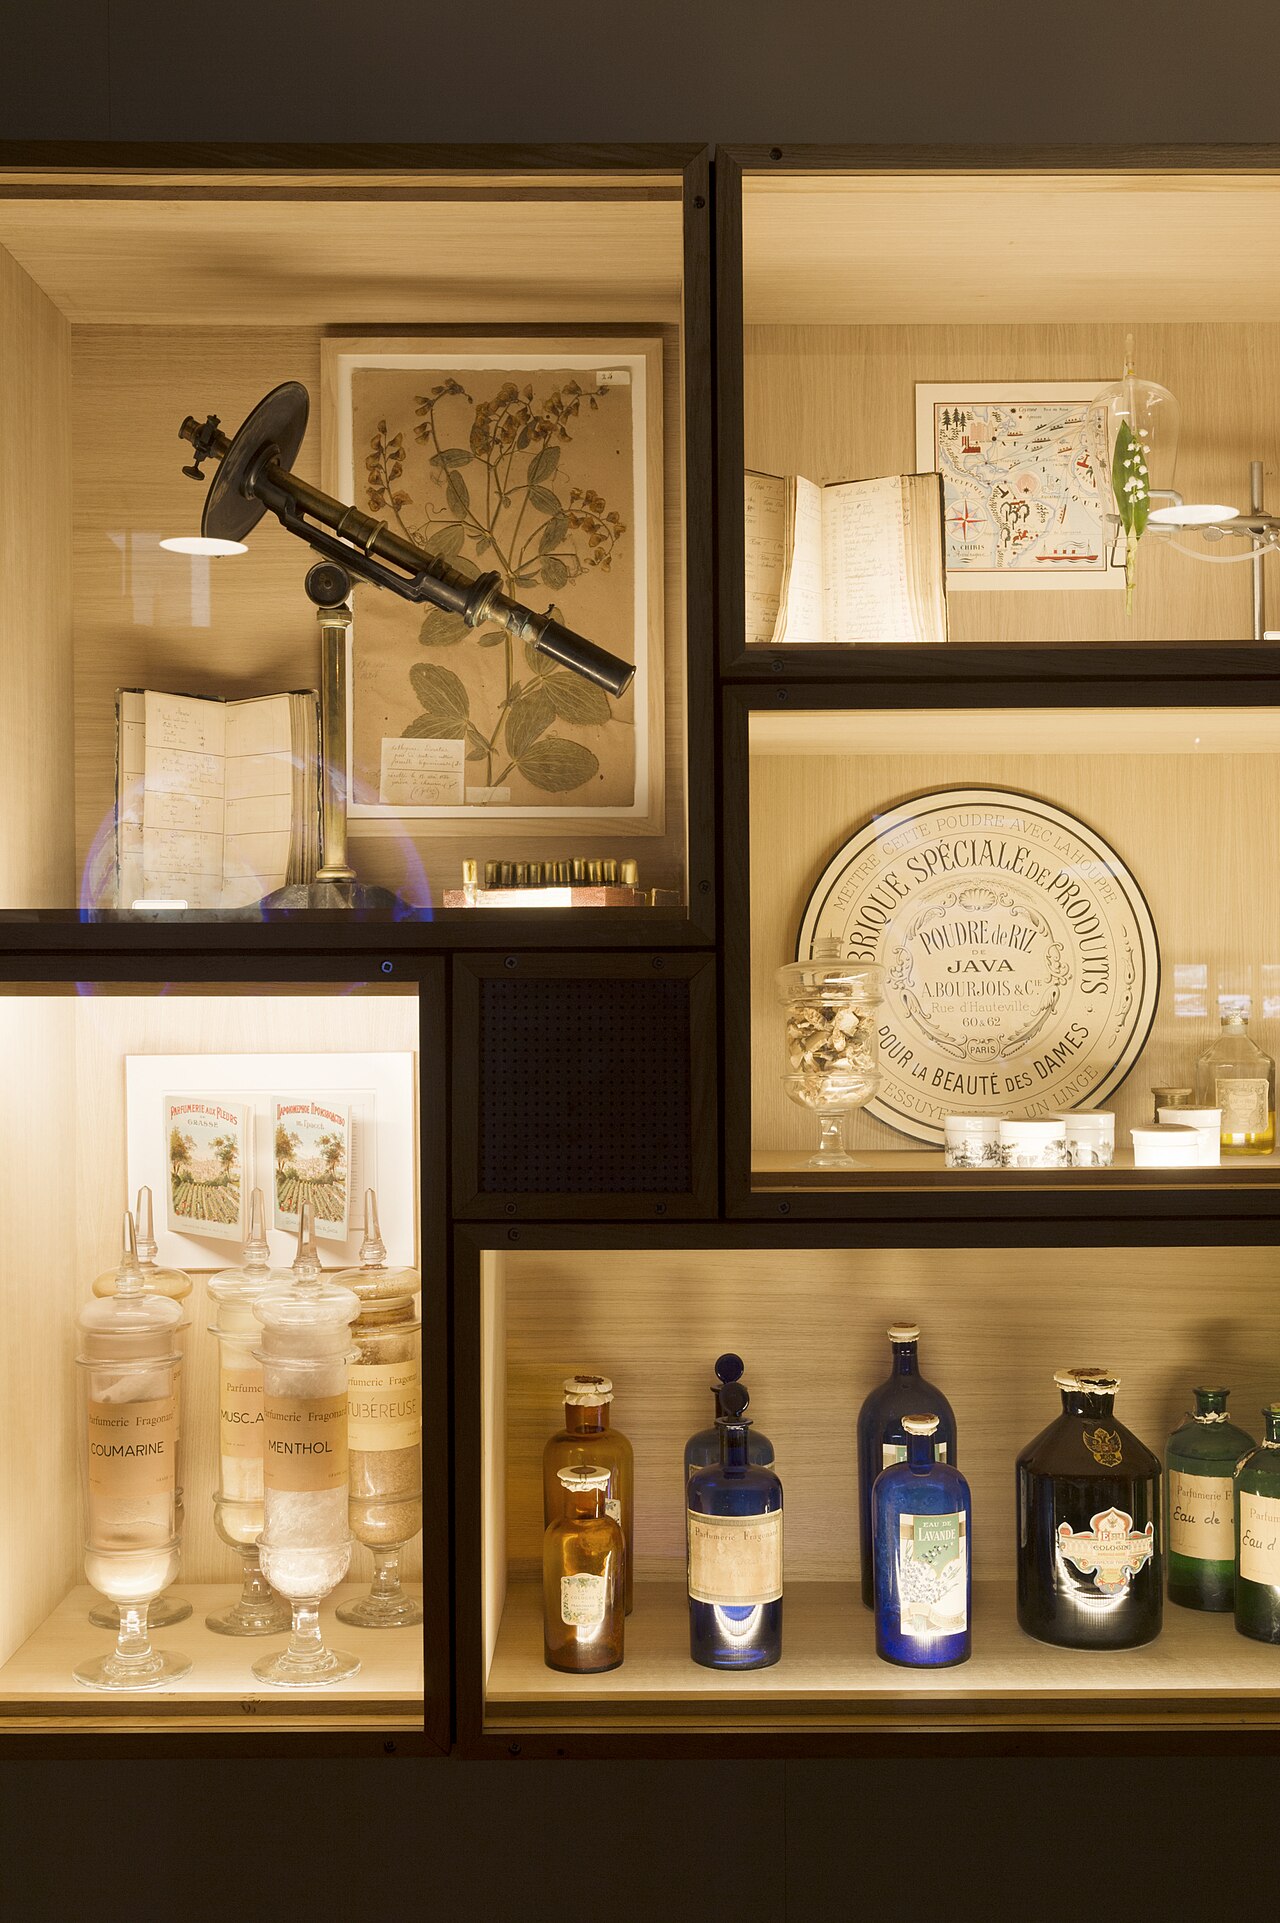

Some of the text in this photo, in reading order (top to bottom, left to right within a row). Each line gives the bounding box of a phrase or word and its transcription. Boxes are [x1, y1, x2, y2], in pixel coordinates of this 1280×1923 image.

[833, 813, 1118, 911] METTRE CETTE POUDRE AVEC LA HOUPPE
[906, 839, 1032, 884] SPÉCIALE
[1025, 860, 1052, 887] DE
[1045, 869, 1110, 996] PRODUITS
[919, 920, 989, 955] POUDRE
[1008, 924, 1038, 954] RIZ
[947, 959, 1015, 973] JAVA
[931, 1000, 1030, 1013] Rue d'Hauteville
[970, 1045, 996, 1054] PARIS
[878, 1022, 1089, 1096] POUR LA BEAUTÉ DES DAMES
[1023, 1099, 1050, 1119] UN
[1052, 1064, 1099, 1106] LINGE
[187, 1119, 219, 1128] GRASSE
[91, 1441, 164, 1457] COUMARINE
[268, 1439, 333, 1455] MENTHOL
[1176, 1485, 1222, 1501] Parfumerie
[1173, 1505, 1221, 1525] Eau de
[694, 1525, 779, 1543] Parfumerie Fragonard
[918, 1527, 956, 1542] LAVANDE
[1242, 1529, 1263, 1549] Eau
